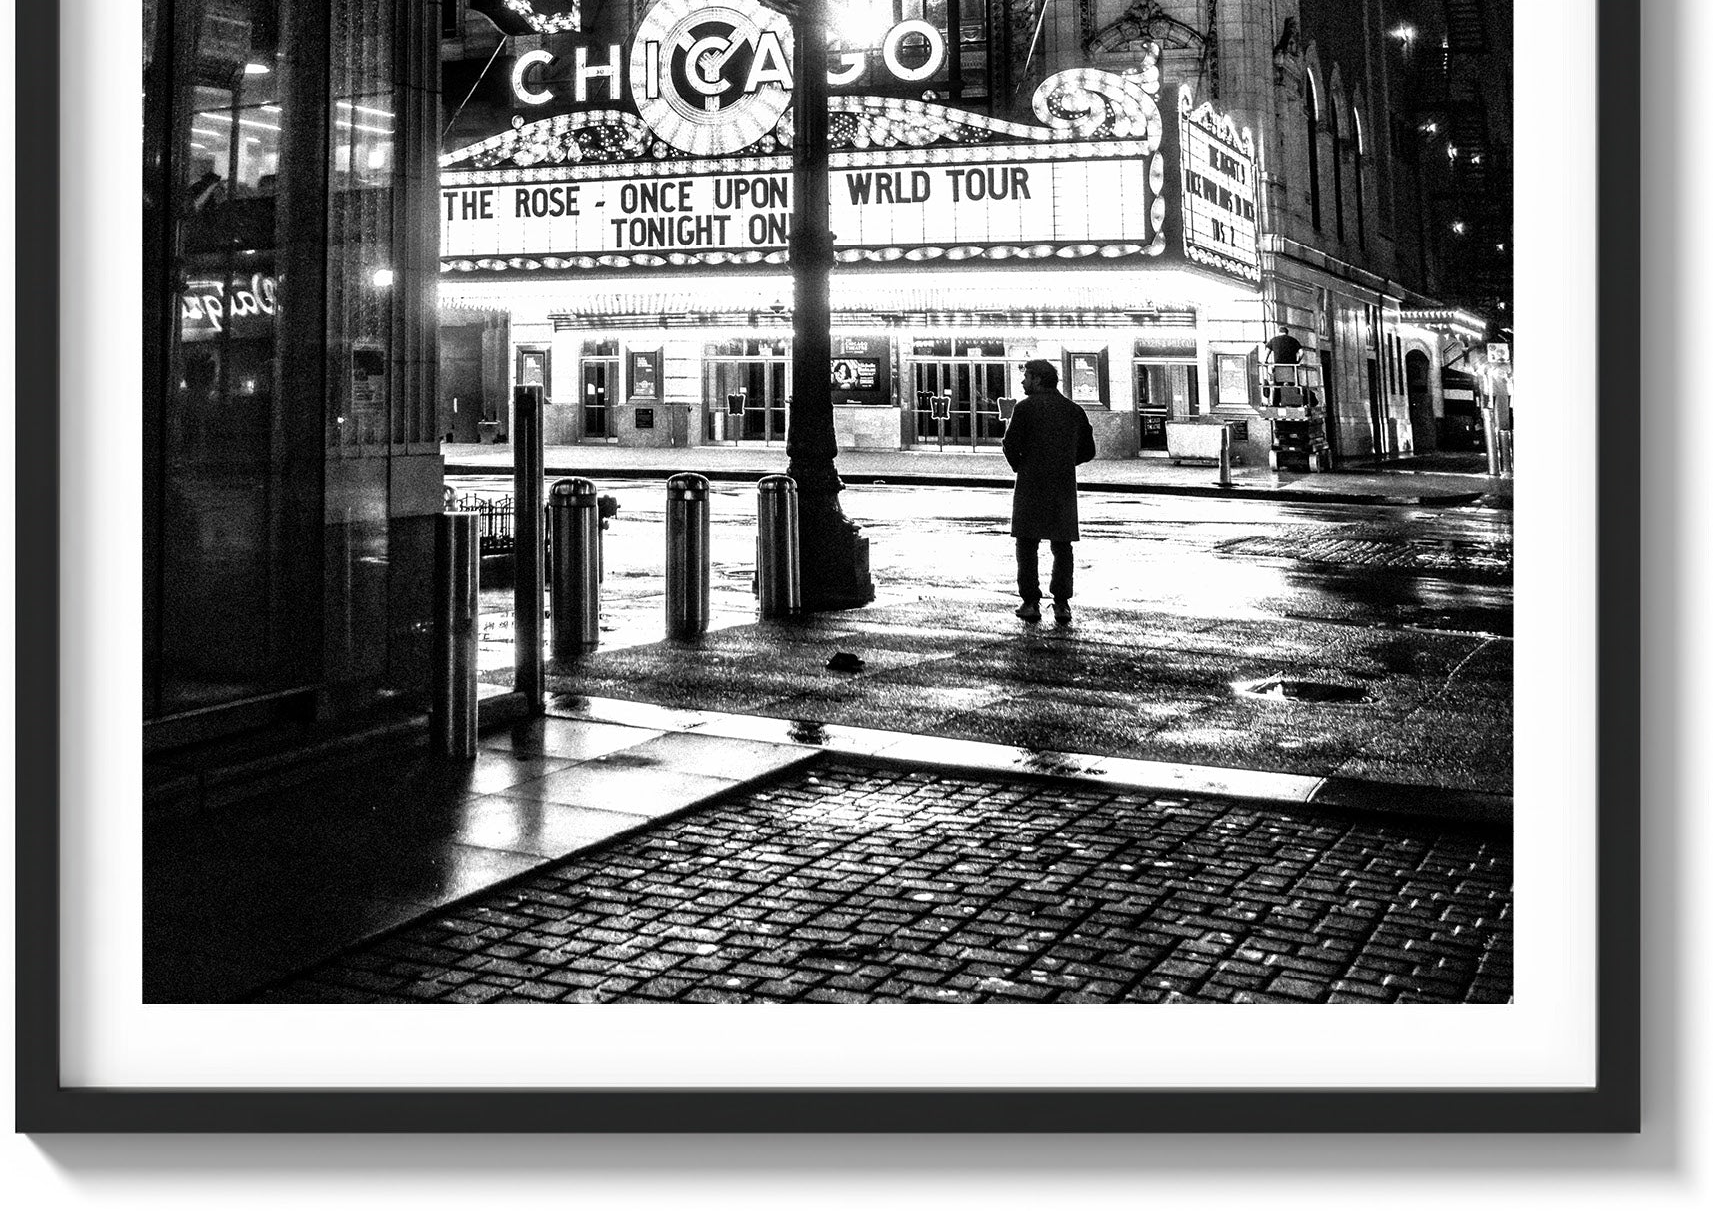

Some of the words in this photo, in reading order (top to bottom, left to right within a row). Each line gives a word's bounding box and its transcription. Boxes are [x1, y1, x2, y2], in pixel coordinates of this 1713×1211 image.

[443, 190, 494, 221] THE
[515, 186, 581, 218] ROSE
[620, 180, 694, 214] ONCE
[714, 177, 789, 210] UPON
[846, 170, 931, 206] WRLD
[946, 166, 1032, 203] TOUR
[611, 214, 731, 248] TONIGHT
[748, 212, 792, 247] ON
